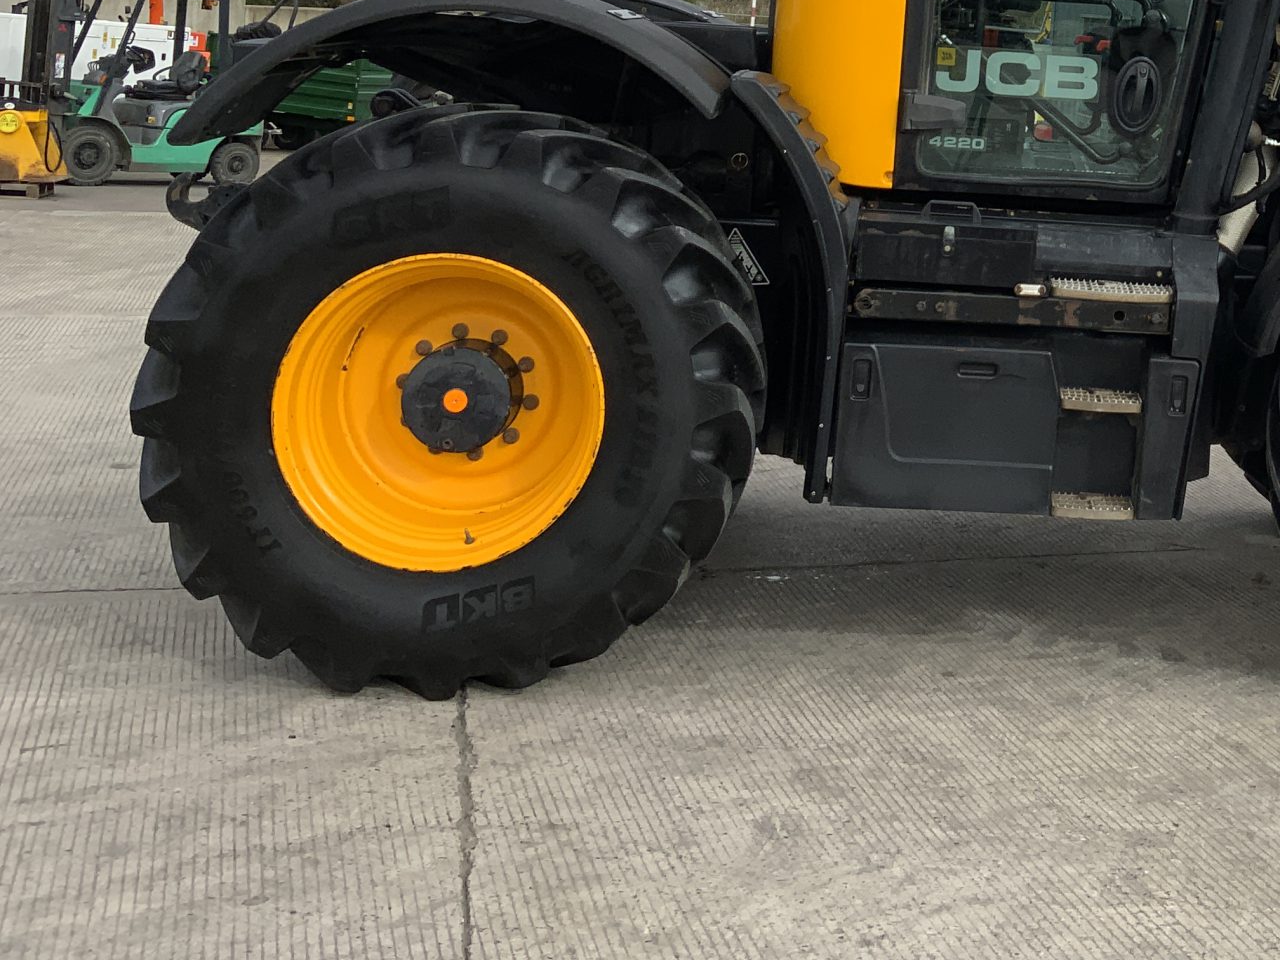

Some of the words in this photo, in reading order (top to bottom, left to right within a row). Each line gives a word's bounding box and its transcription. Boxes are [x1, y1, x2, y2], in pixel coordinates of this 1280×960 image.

[935, 49, 1099, 100] JCB
[928, 135, 986, 150] 4220
[421, 575, 536, 634] BKT
